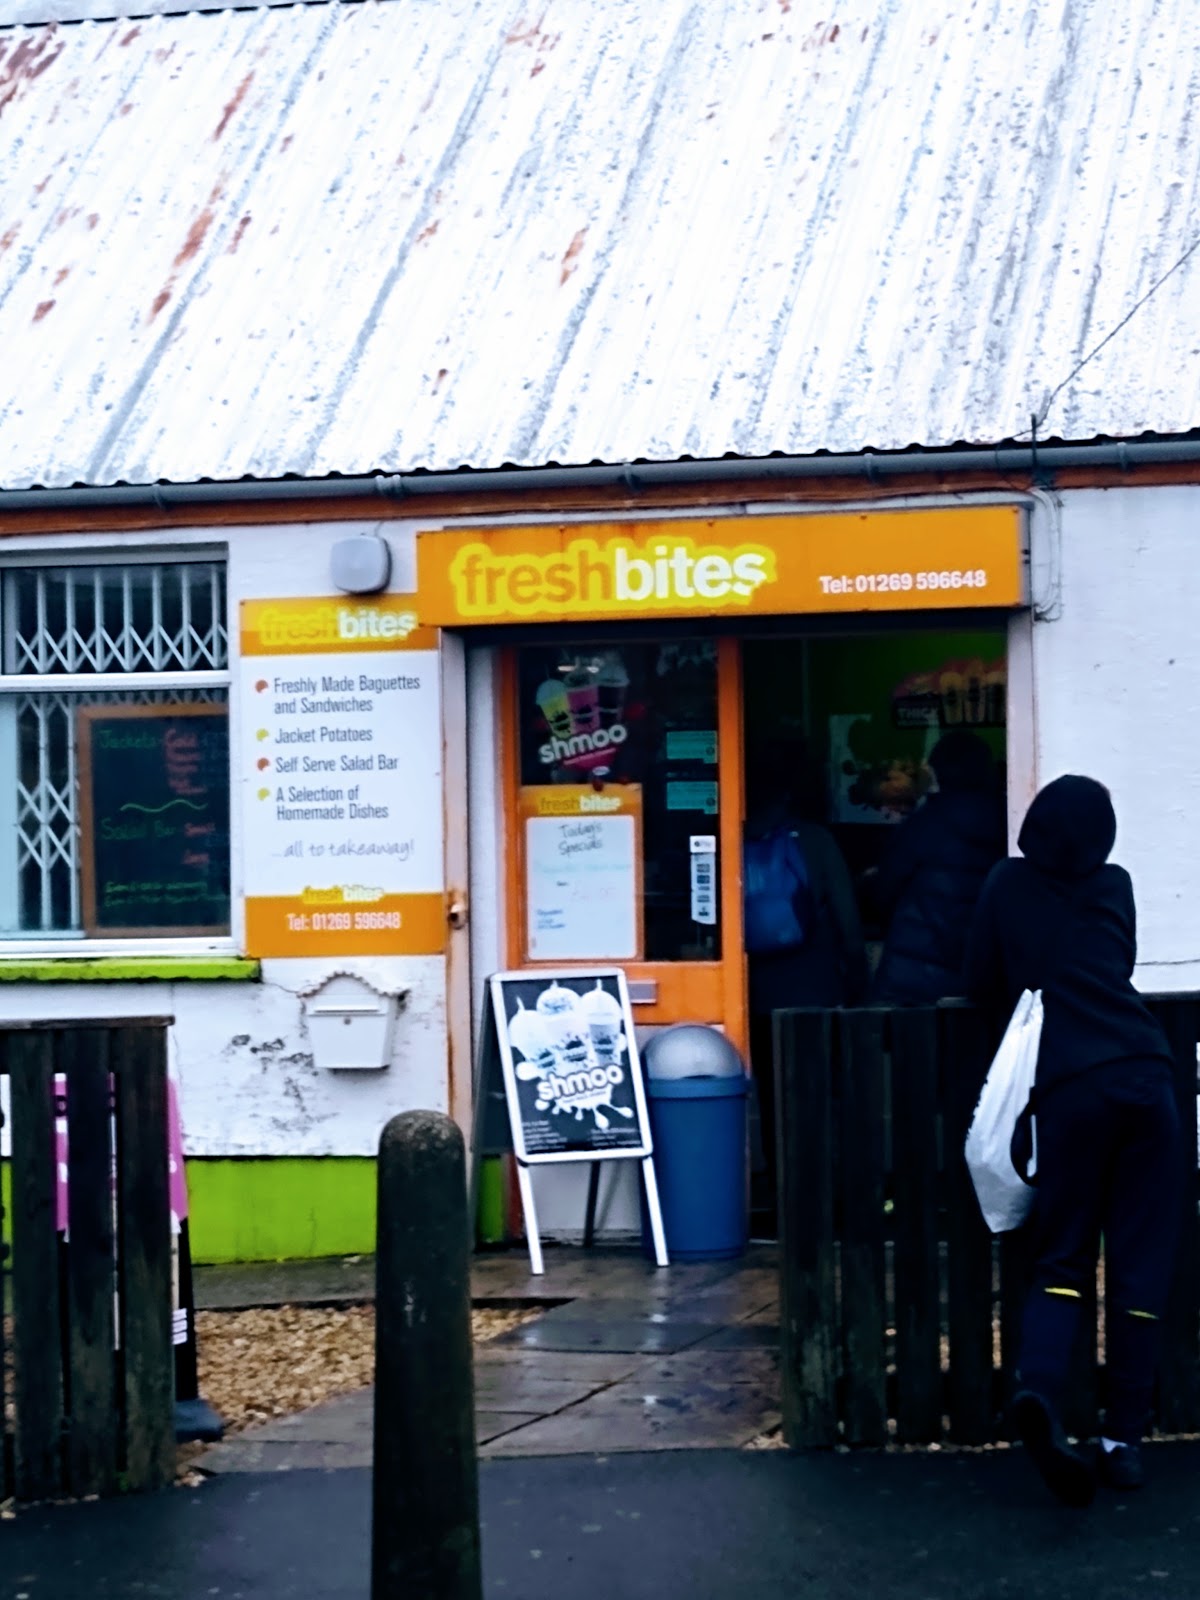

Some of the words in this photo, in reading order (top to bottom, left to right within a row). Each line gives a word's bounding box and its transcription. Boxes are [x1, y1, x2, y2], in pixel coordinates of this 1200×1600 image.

[820, 575, 853, 594] Tel:
[855, 573, 913, 593] 01269
[916, 570, 987, 590] 596648
[274, 676, 317, 695] Freshly
[322, 676, 355, 692] Made
[359, 674, 421, 694] Baguettes
[274, 698, 297, 714] and
[301, 696, 373, 714] Sandwiches
[275, 728, 315, 744] Jacket
[320, 726, 373, 742] Potatoes
[538, 723, 628, 764] shmoo
[276, 756, 298, 773] Self
[303, 756, 336, 772] Serve
[341, 754, 374, 771] Salad
[378, 754, 399, 770] Bar
[276, 787, 285, 802] A
[289, 785, 344, 802] Selection
[348, 784, 360, 801] of
[277, 804, 345, 821] Homemade
[350, 803, 389, 819] Dishes
[309, 843, 324, 857] to
[329, 838, 415, 861] takeaway!
[287, 914, 309, 930] Tel:
[312, 913, 351, 930] 01269
[354, 912, 401, 929] 596648
[537, 1064, 624, 1101] shmoo
